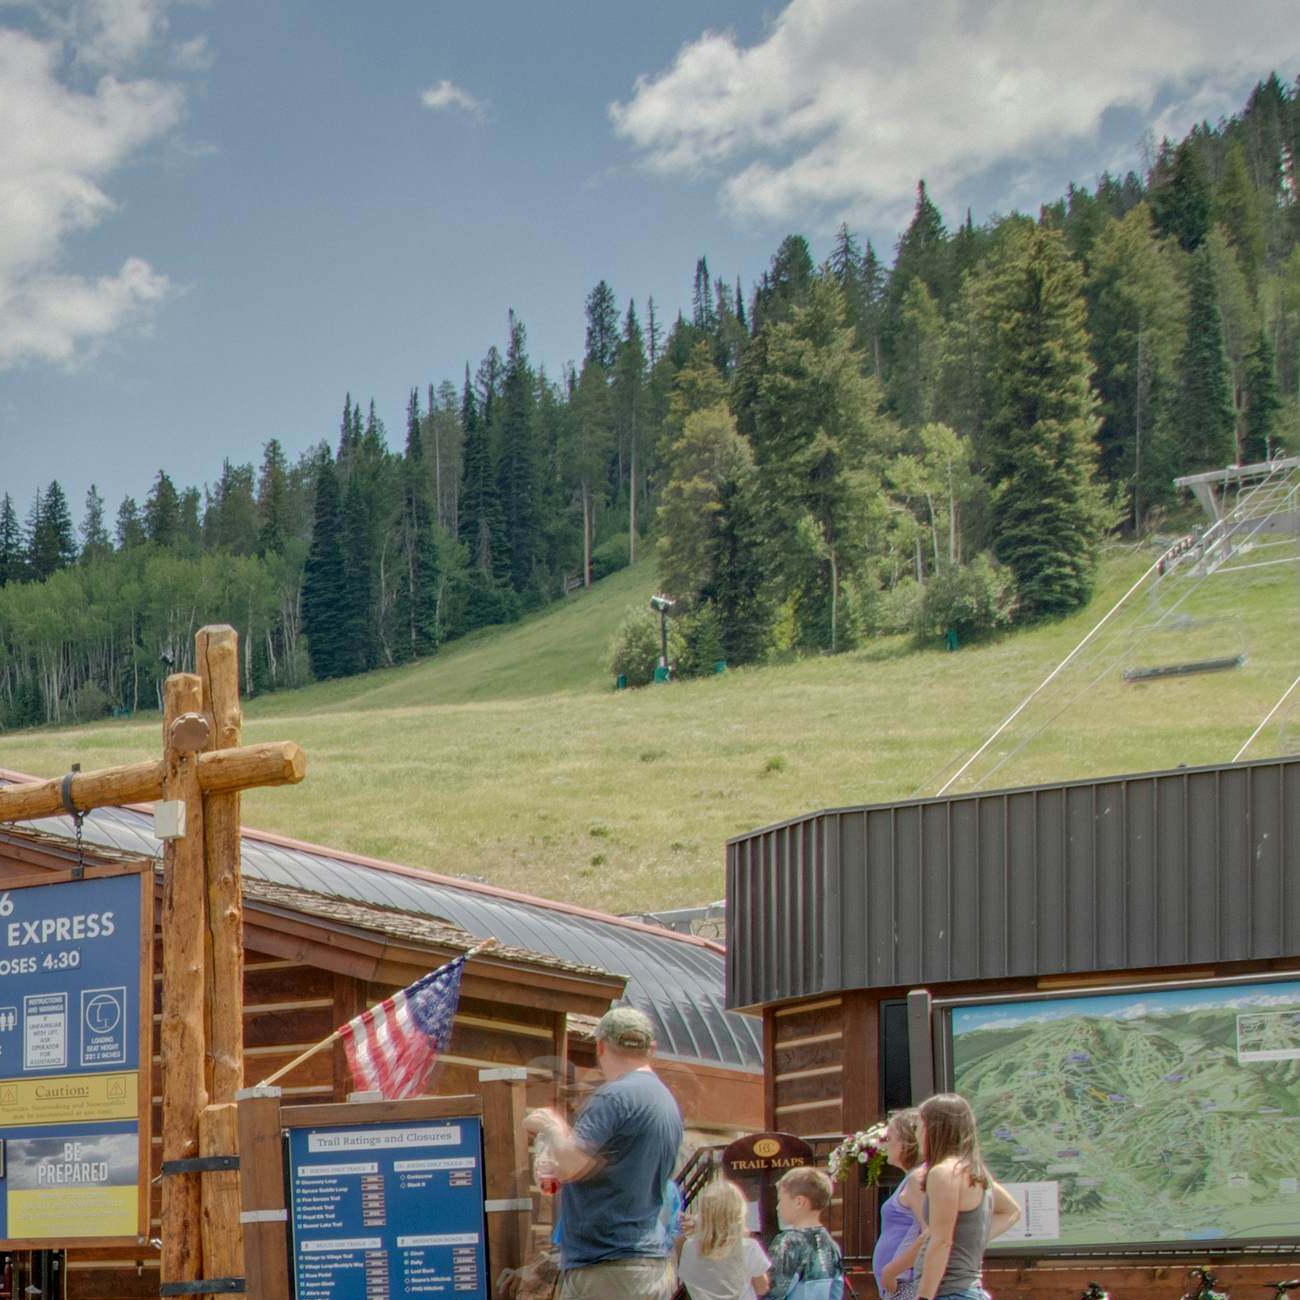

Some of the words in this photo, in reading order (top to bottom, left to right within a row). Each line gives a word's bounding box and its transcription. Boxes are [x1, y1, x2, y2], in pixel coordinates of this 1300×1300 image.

[7, 911, 115, 947] EXPRESS
[42, 951, 80, 969] 4:30
[35, 1085, 90, 1098] Caution:
[318, 1137, 340, 1147] Trail
[343, 1135, 381, 1146] Ratings
[384, 1134, 403, 1143] and
[406, 1132, 452, 1142] Closures
[64, 1142, 81, 1162] BE
[731, 1160, 768, 1170] TRAIL
[771, 1157, 804, 1167] MAPS
[38, 1162, 108, 1184] PREPARED
